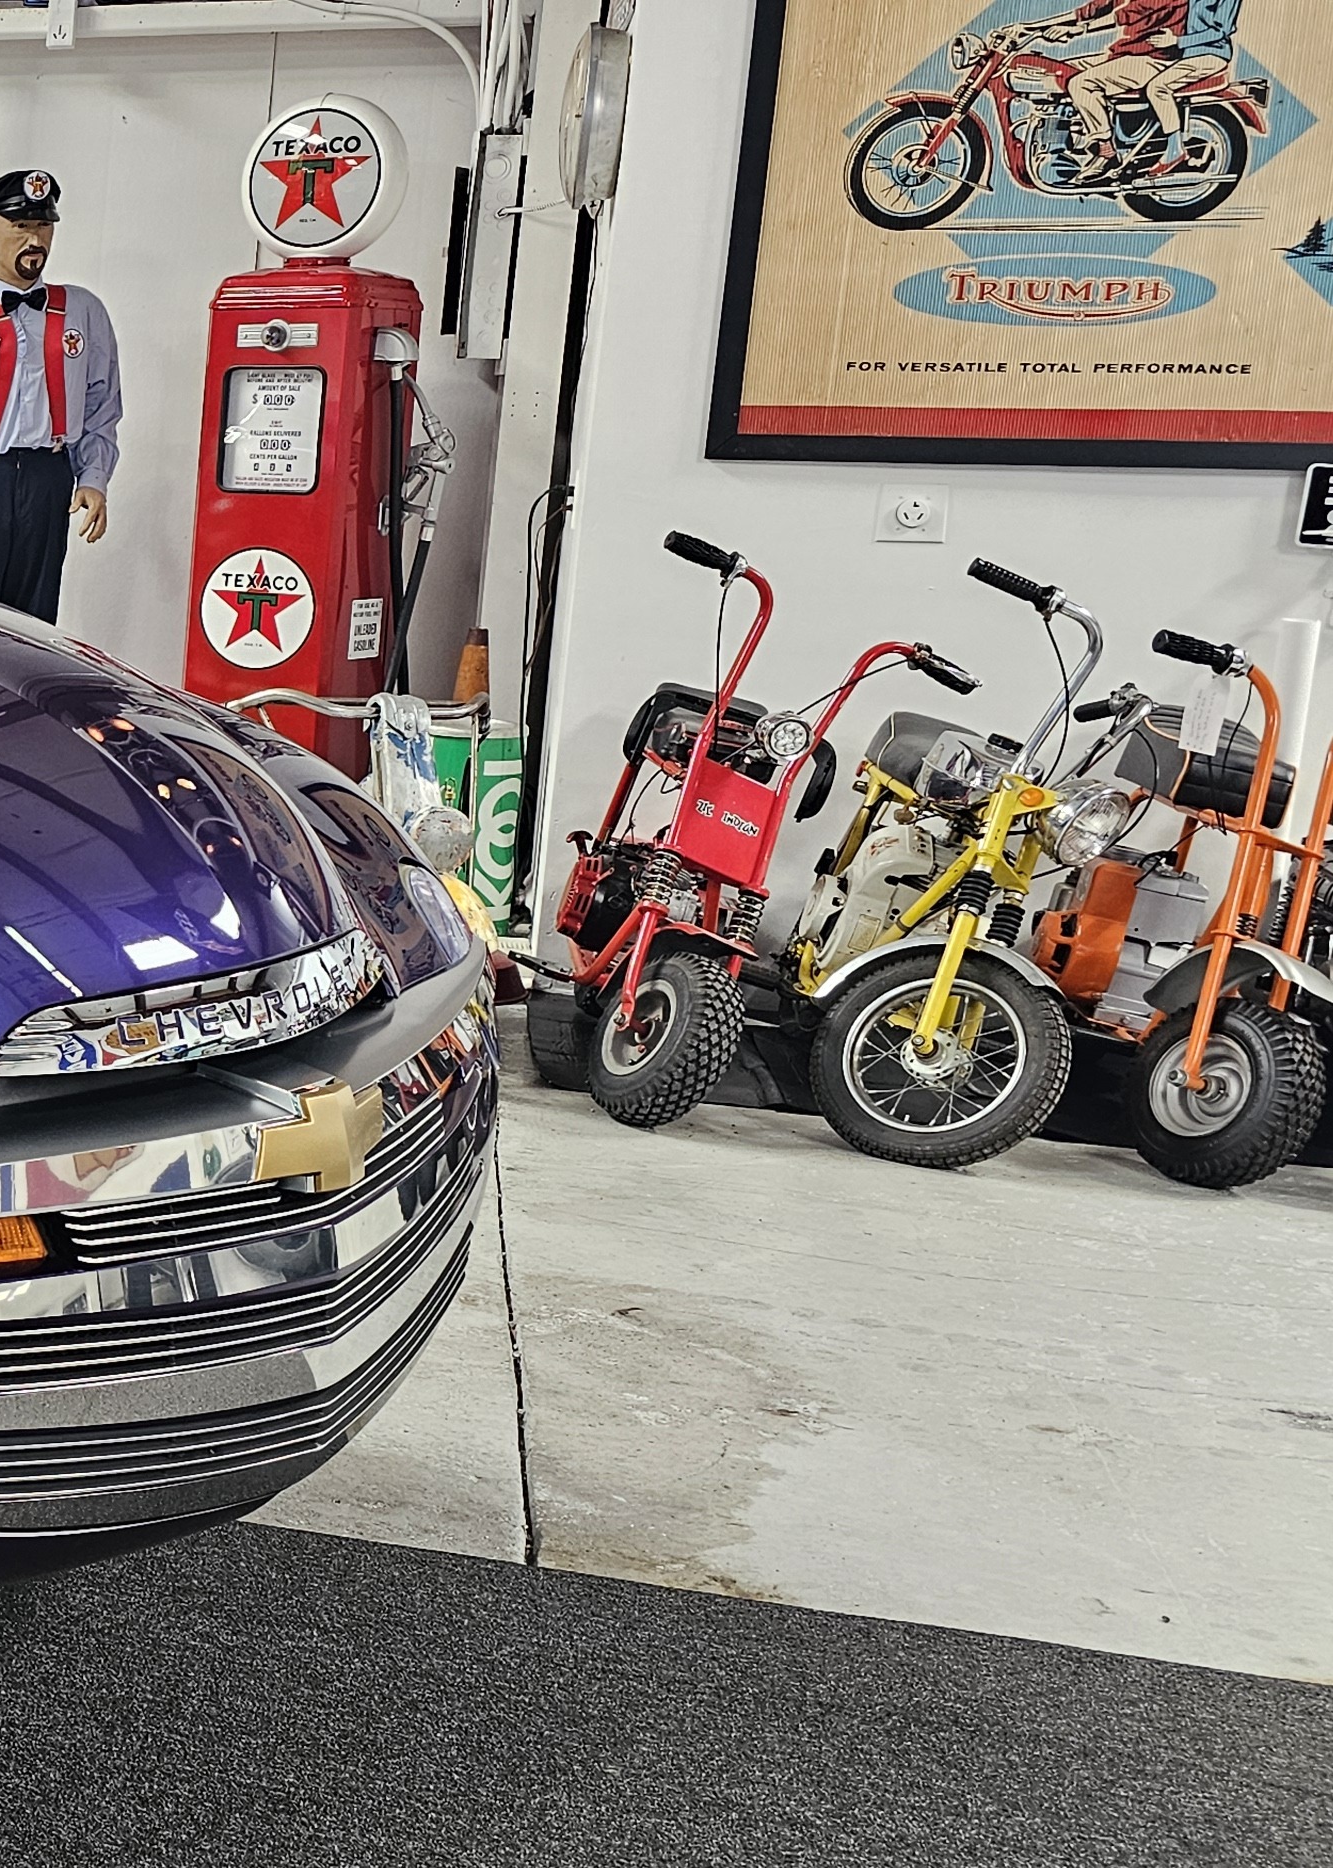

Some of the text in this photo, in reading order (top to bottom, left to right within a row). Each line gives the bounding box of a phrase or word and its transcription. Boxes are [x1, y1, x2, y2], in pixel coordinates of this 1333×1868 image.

[271, 135, 362, 157] TEXACO
[945, 266, 1171, 306] TRIUMPH
[846, 361, 1252, 375] FOR VERSATILE TOTAL PERFORMANCE
[221, 572, 299, 591] TEXACO
